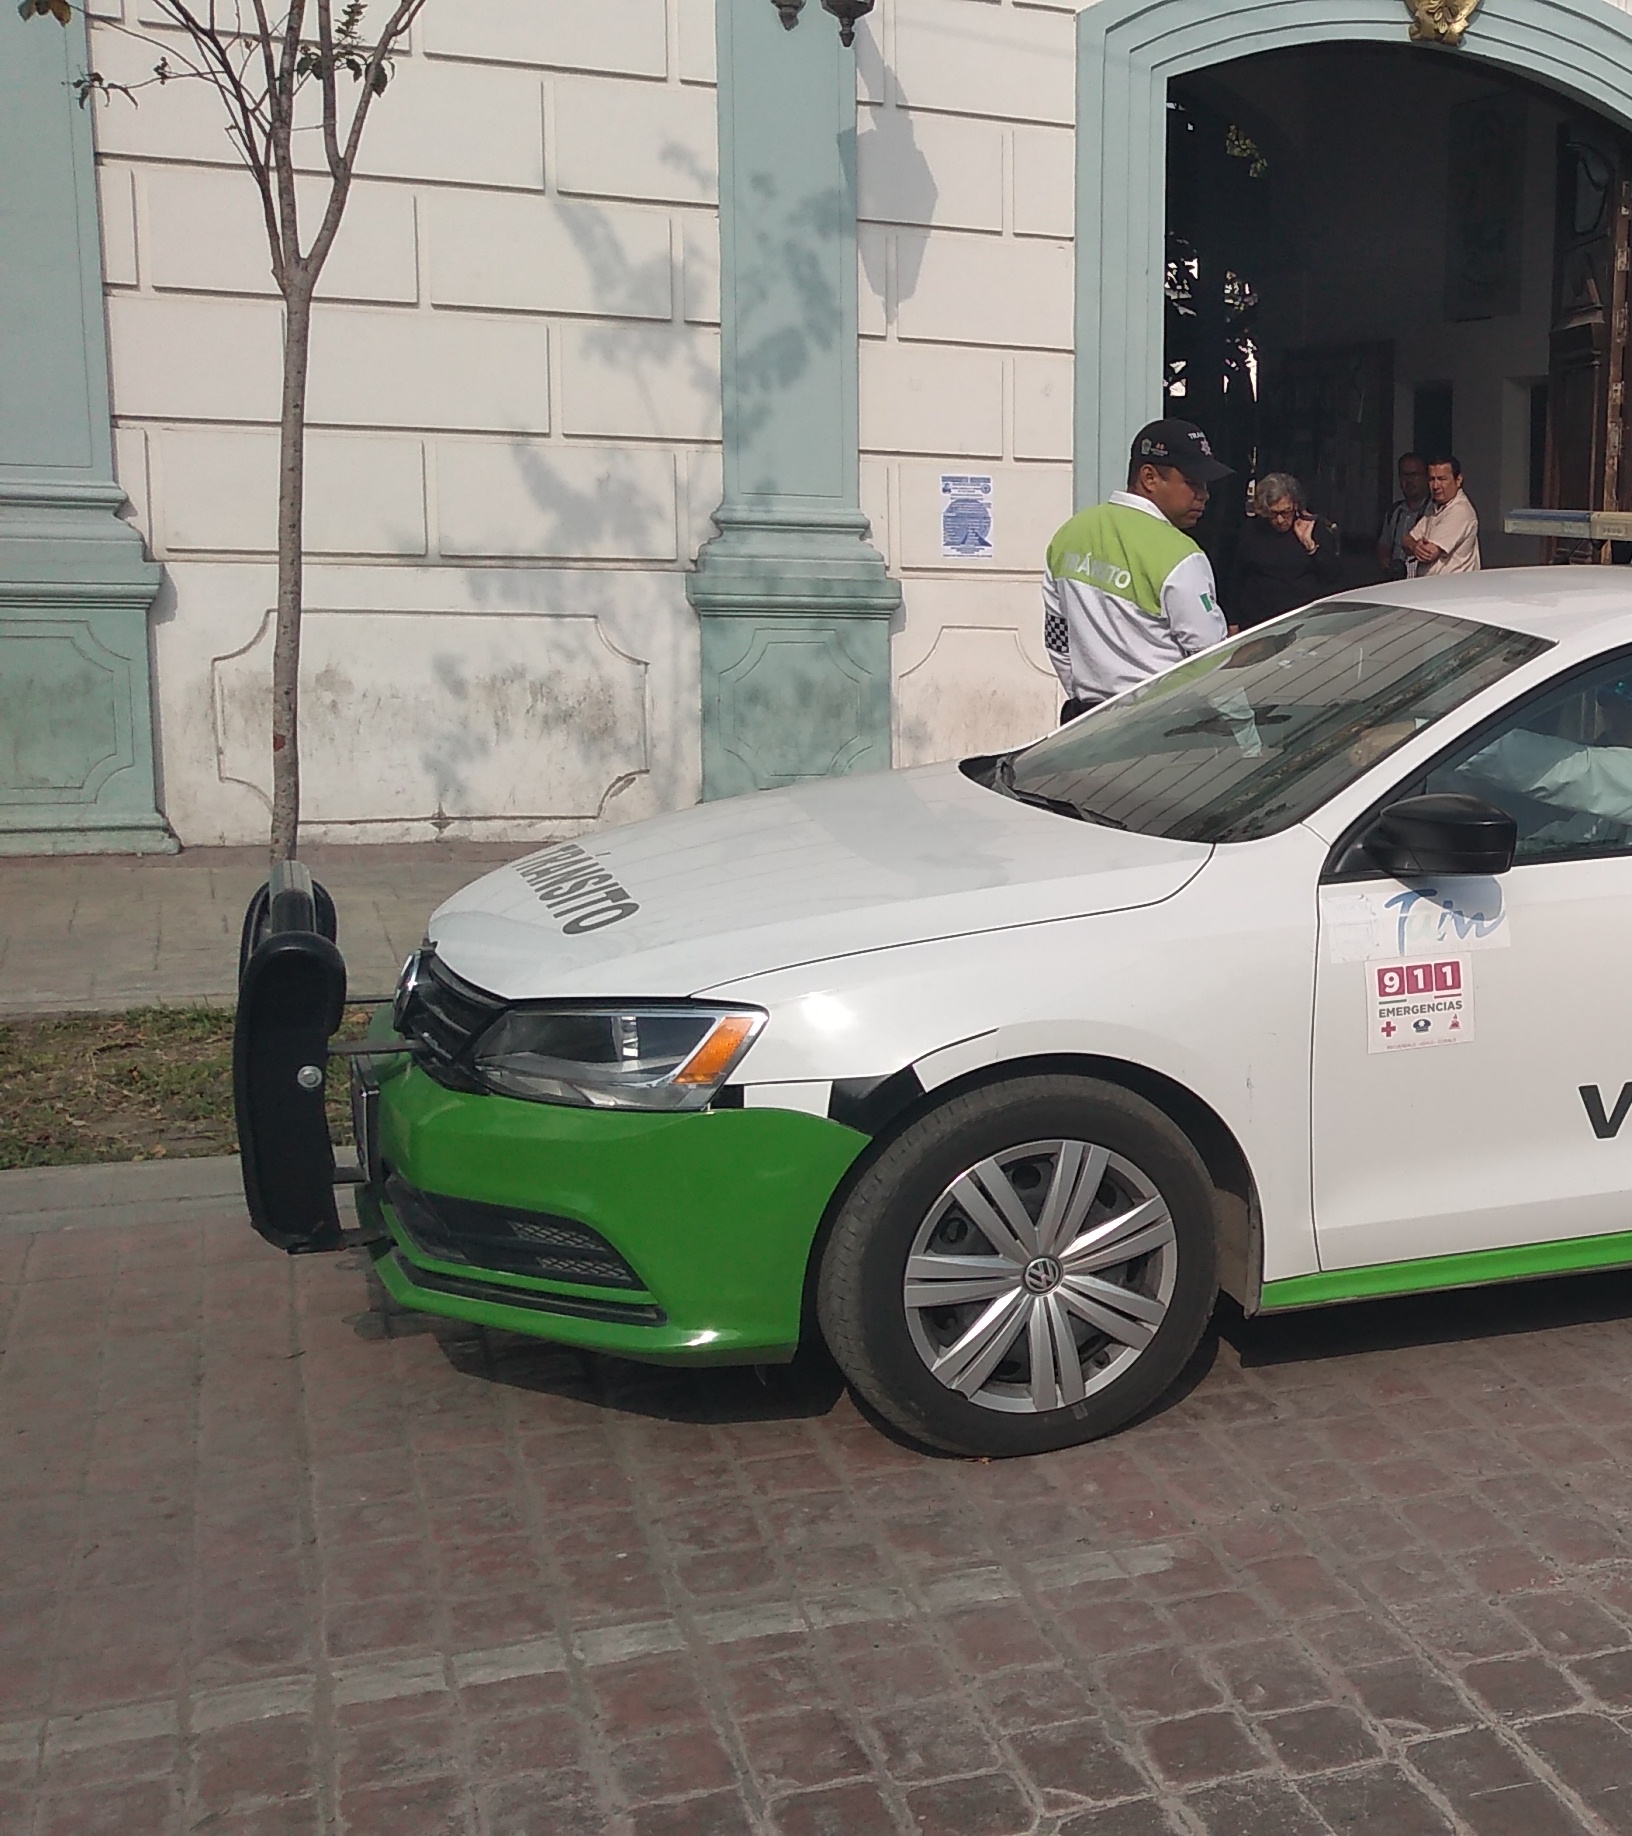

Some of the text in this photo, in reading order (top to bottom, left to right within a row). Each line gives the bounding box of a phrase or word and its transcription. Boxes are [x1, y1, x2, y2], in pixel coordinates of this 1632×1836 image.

[511, 843, 640, 935] TRÁNSITO
[1383, 965, 1453, 993] 911
[1379, 1000, 1463, 1018] EMERGENCIAS
